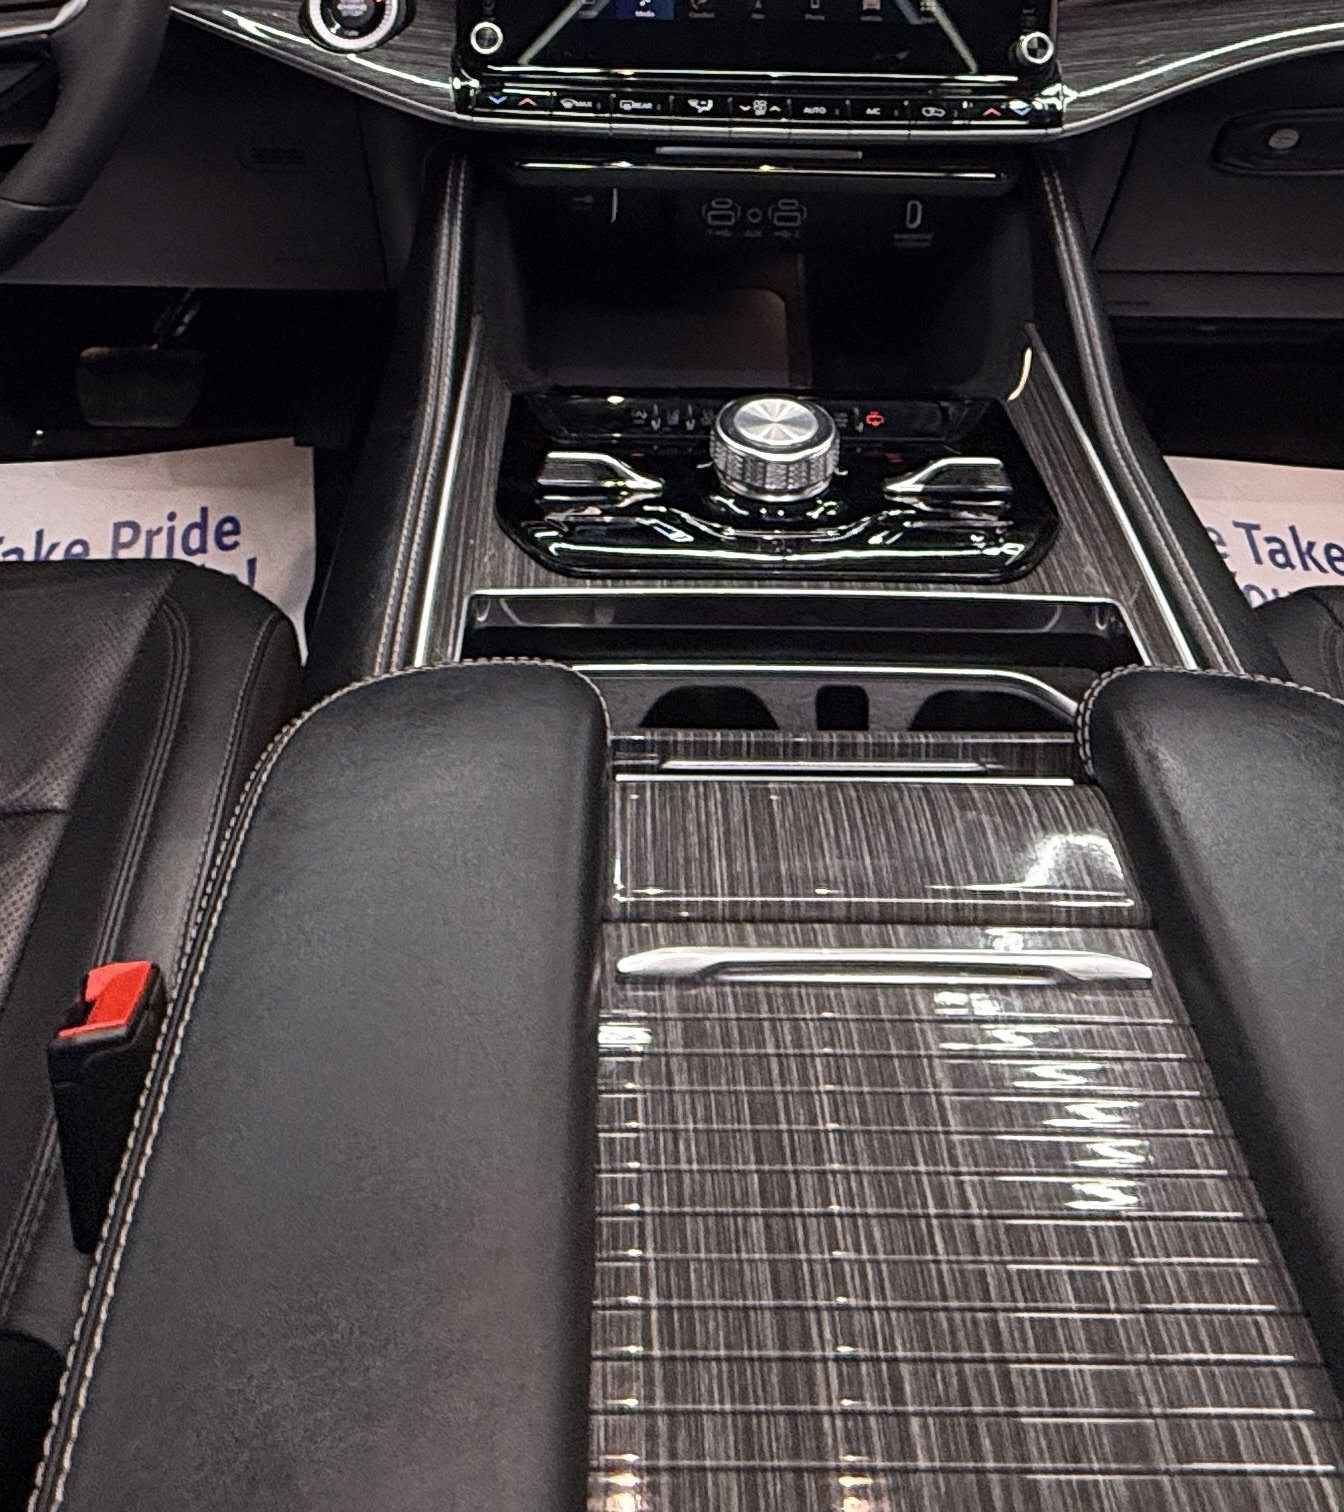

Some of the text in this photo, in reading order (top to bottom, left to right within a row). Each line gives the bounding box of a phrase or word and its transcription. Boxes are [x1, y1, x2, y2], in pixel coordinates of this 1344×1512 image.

[803, 106, 828, 115] AUTO
[865, 107, 881, 115] A/C
[110, 506, 242, 559] Pride
